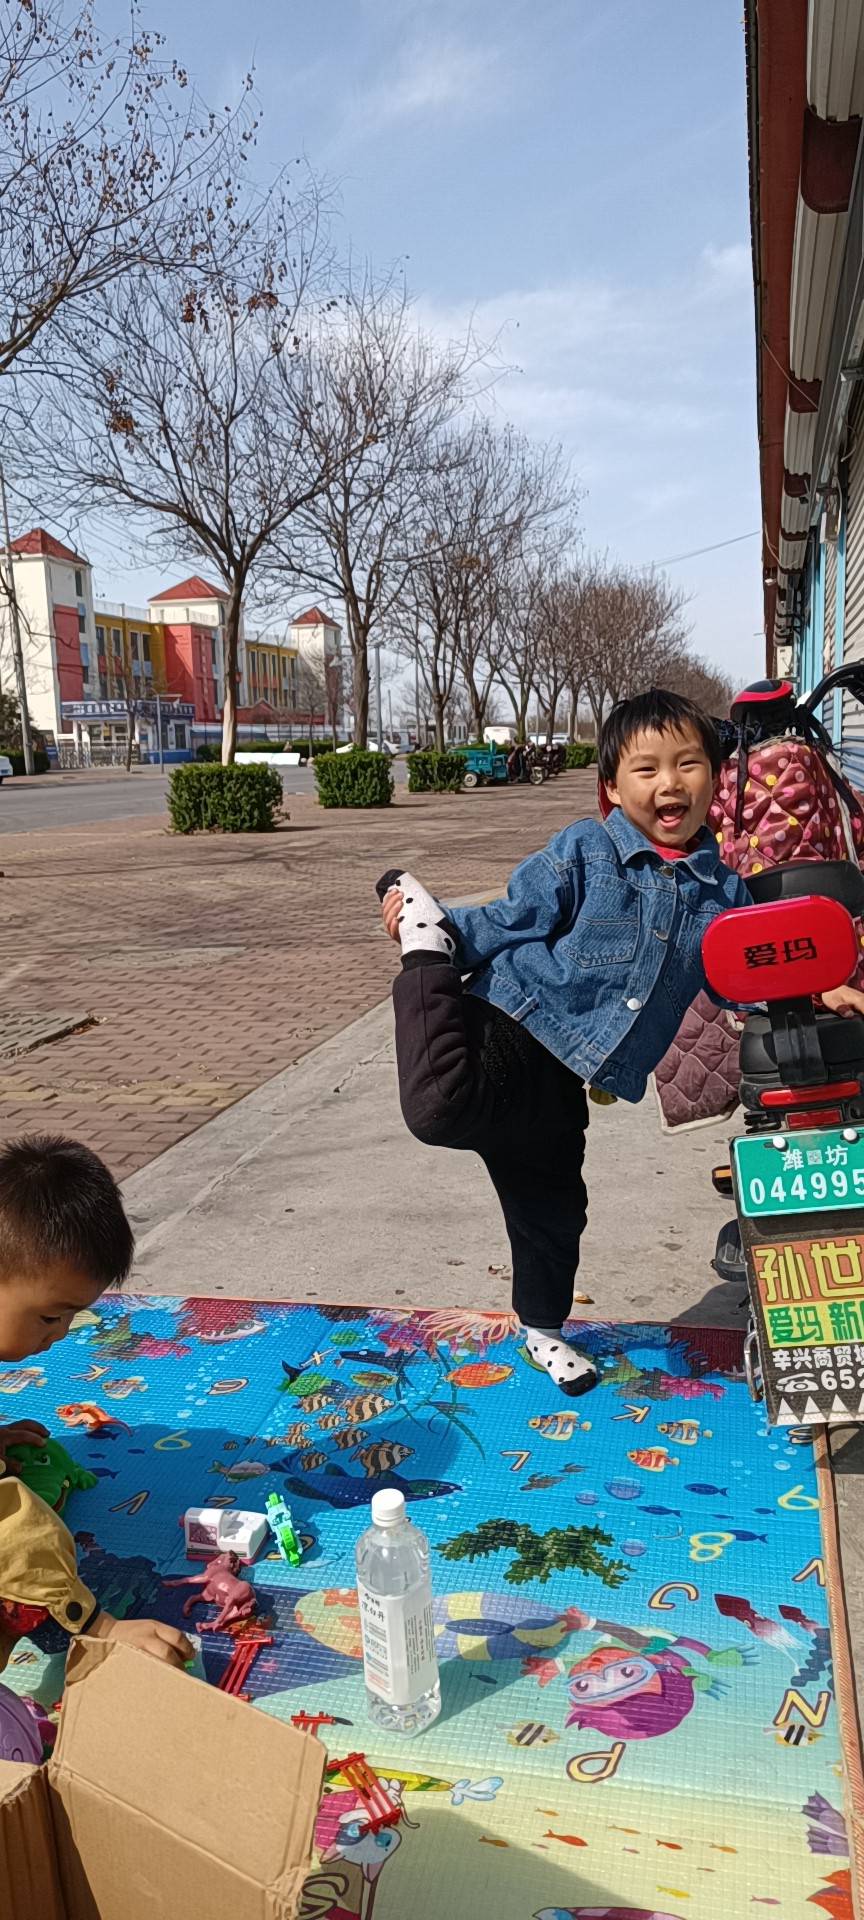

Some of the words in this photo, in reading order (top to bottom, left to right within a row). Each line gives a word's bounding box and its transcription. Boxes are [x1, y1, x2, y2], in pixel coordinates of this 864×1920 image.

[743, 936, 818, 970] 爱玛
[749, 1168, 864, 1205] 044995
[767, 1305, 825, 1344] 爱玛
[828, 1300, 864, 1342] 新
[688, 1530, 735, 1563] 8
[772, 1689, 833, 1728] N
